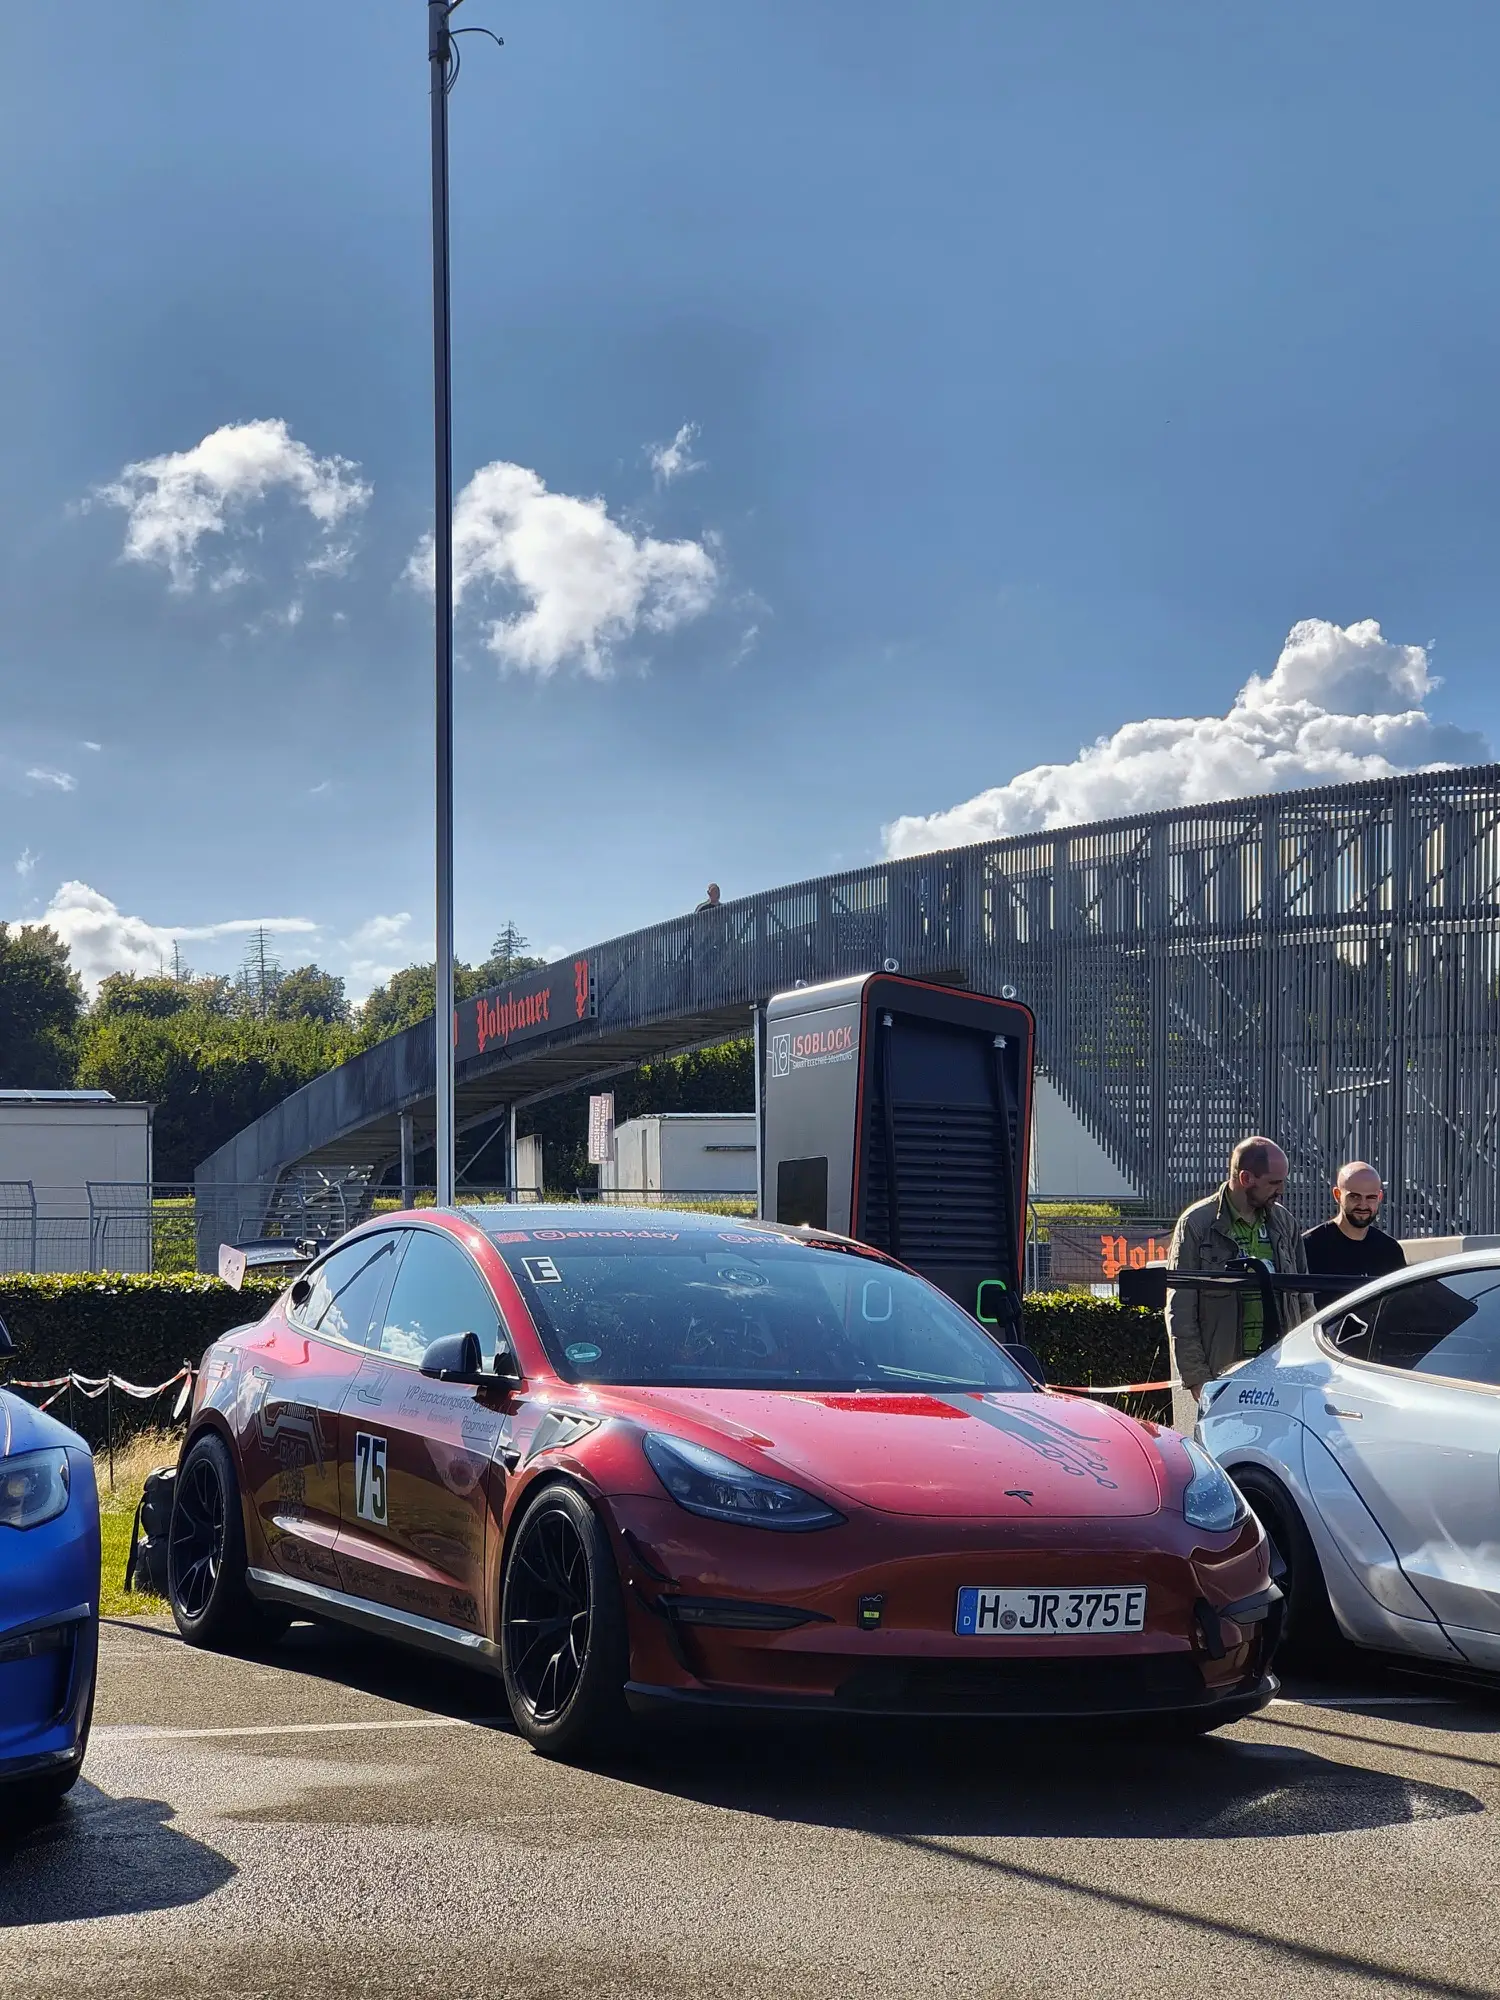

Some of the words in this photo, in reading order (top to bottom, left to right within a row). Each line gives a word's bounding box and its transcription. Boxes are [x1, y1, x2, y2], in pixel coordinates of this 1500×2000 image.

[476, 988, 550, 1053] Polybauer
[793, 1026, 852, 1056] ISOBLOCK
[564, 1230, 680, 1241] etrackday
[357, 1434, 386, 1520] 75
[963, 1616, 971, 1626] D
[978, 1594, 1000, 1629] H
